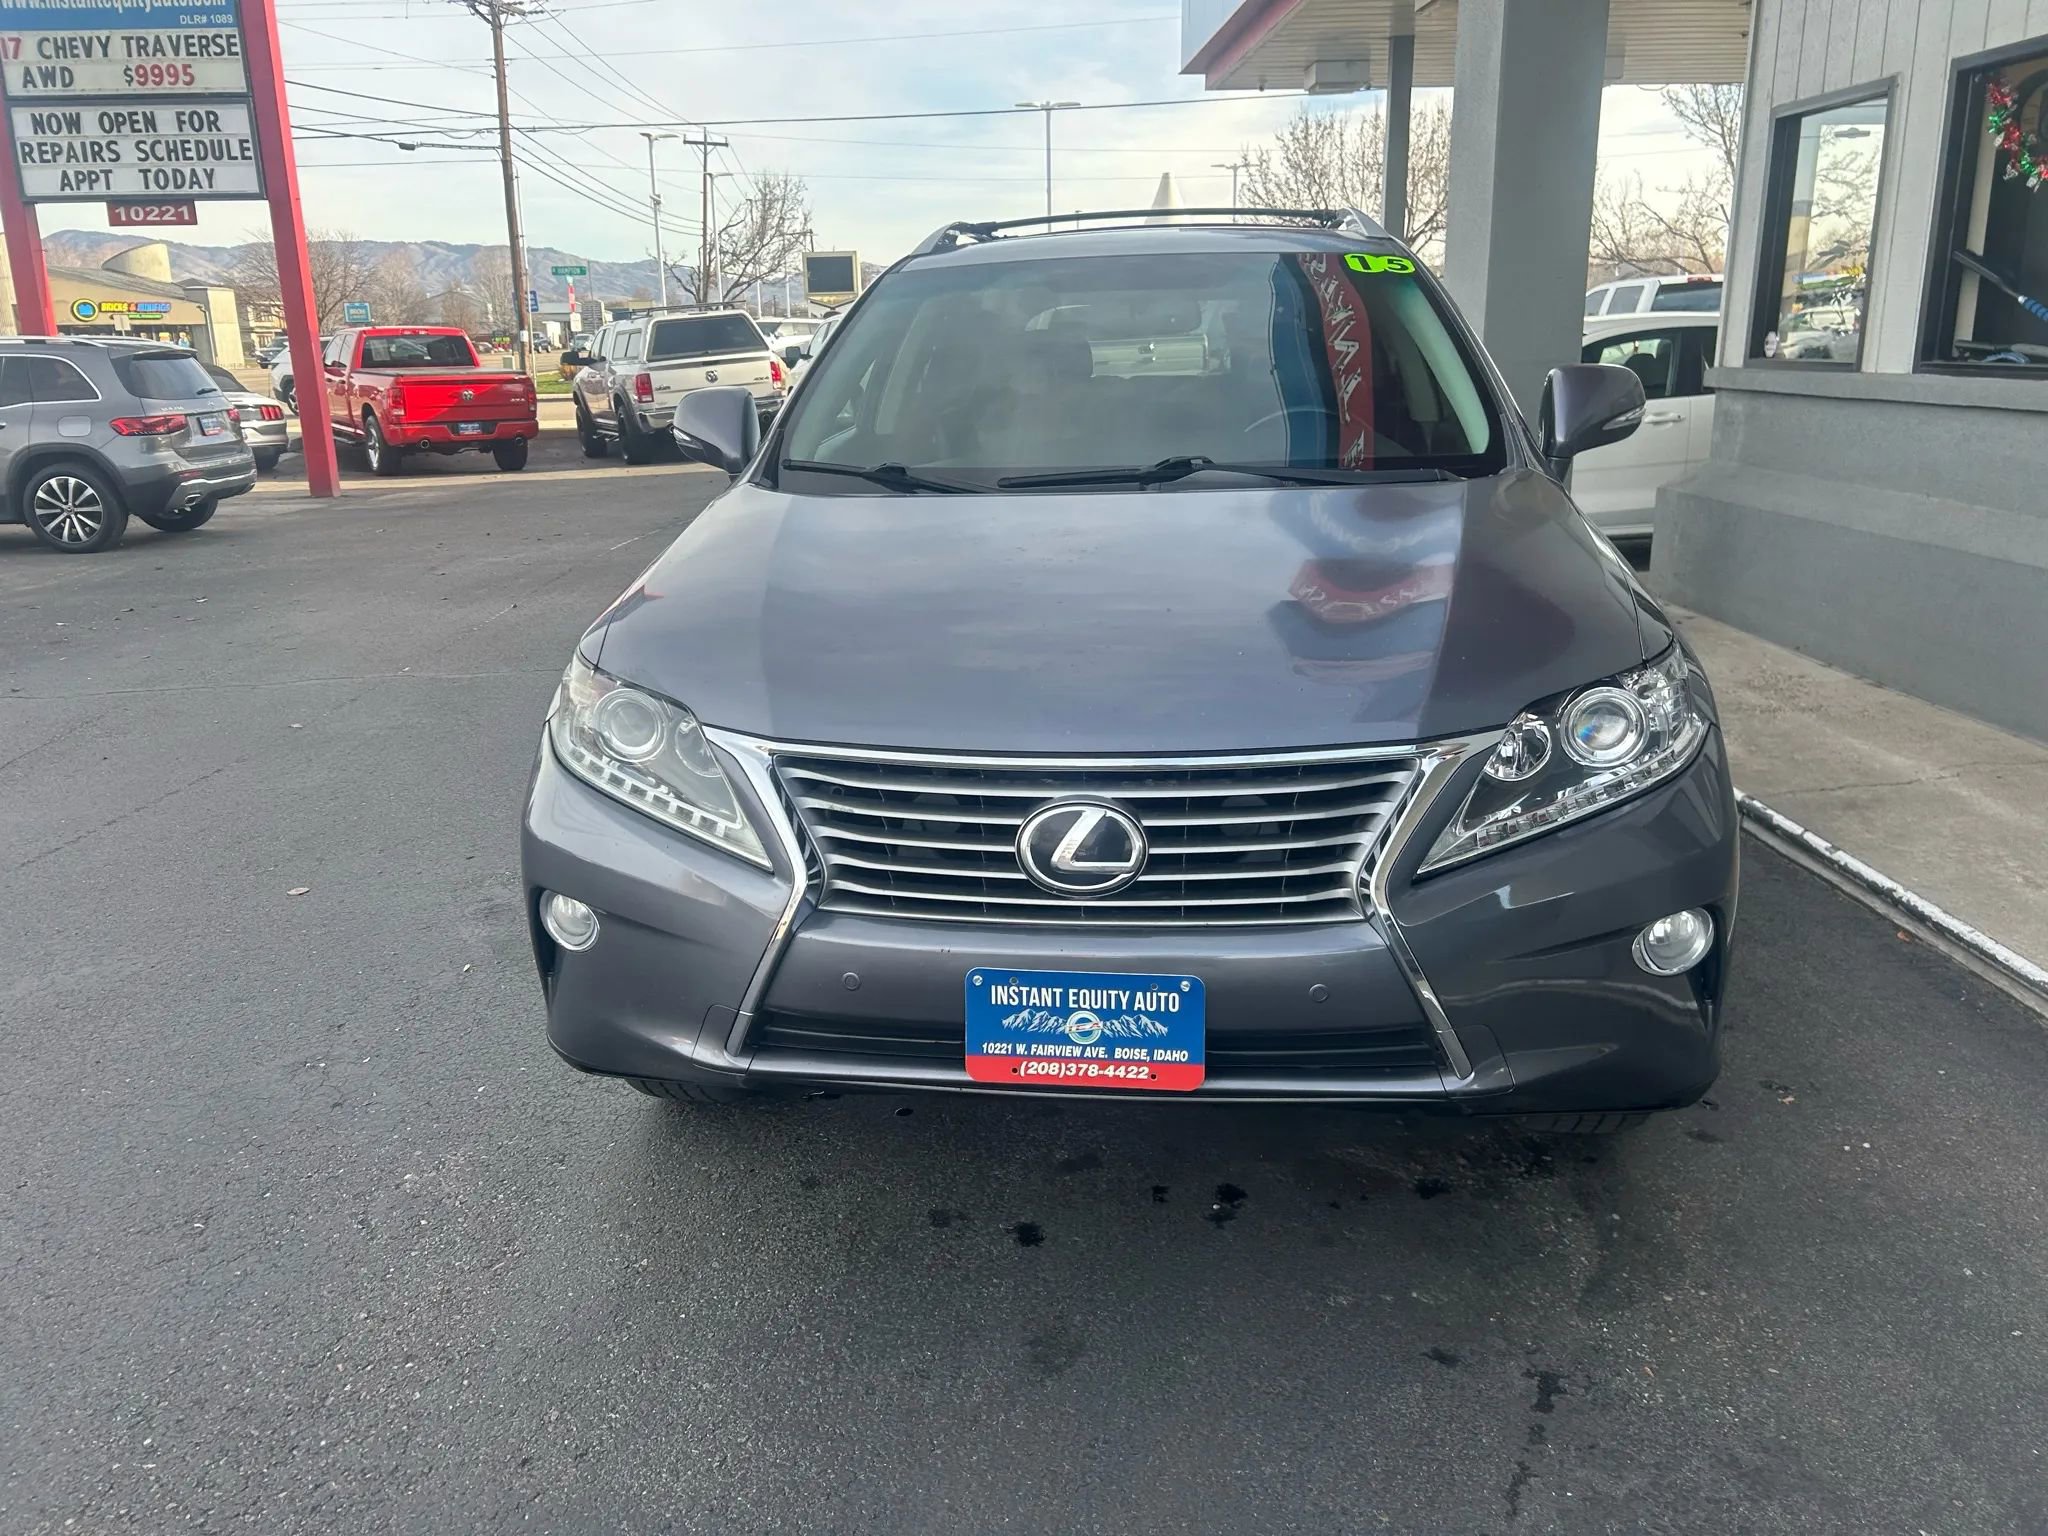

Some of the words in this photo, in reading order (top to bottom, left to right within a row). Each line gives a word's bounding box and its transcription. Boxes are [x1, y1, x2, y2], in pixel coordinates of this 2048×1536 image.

[180, 15, 207, 25] DLR#
[210, 14, 233, 24] 1089
[37, 36, 111, 59] CHEVY
[121, 33, 240, 58] TRAVERSE
[22, 66, 74, 89] AWD
[124, 63, 195, 87] $9995
[31, 112, 81, 135] NOW
[98, 111, 158, 134] OPEN
[176, 110, 222, 133] FOR
[21, 140, 121, 164] REPAIRS
[135, 139, 253, 162] SCHEDULE
[60, 169, 113, 191] APPT
[139, 168, 215, 190] TODAY
[115, 205, 190, 221] 10221
[1350, 255, 1409, 271] 15
[991, 984, 1063, 1008] INSTANT
[1068, 988, 1130, 1011] EQUITY
[1135, 991, 1180, 1012] AUTO
[982, 1042, 1012, 1055] 10221
[1016, 1044, 1028, 1056] W.
[1030, 1044, 1084, 1058] FAIRVIEW
[1084, 1046, 1108, 1059] AVE.
[1114, 1049, 1150, 1063] BOISE,
[1153, 1051, 1189, 1063] IDAHO
[1020, 1060, 1149, 1080] (208)378-4422
